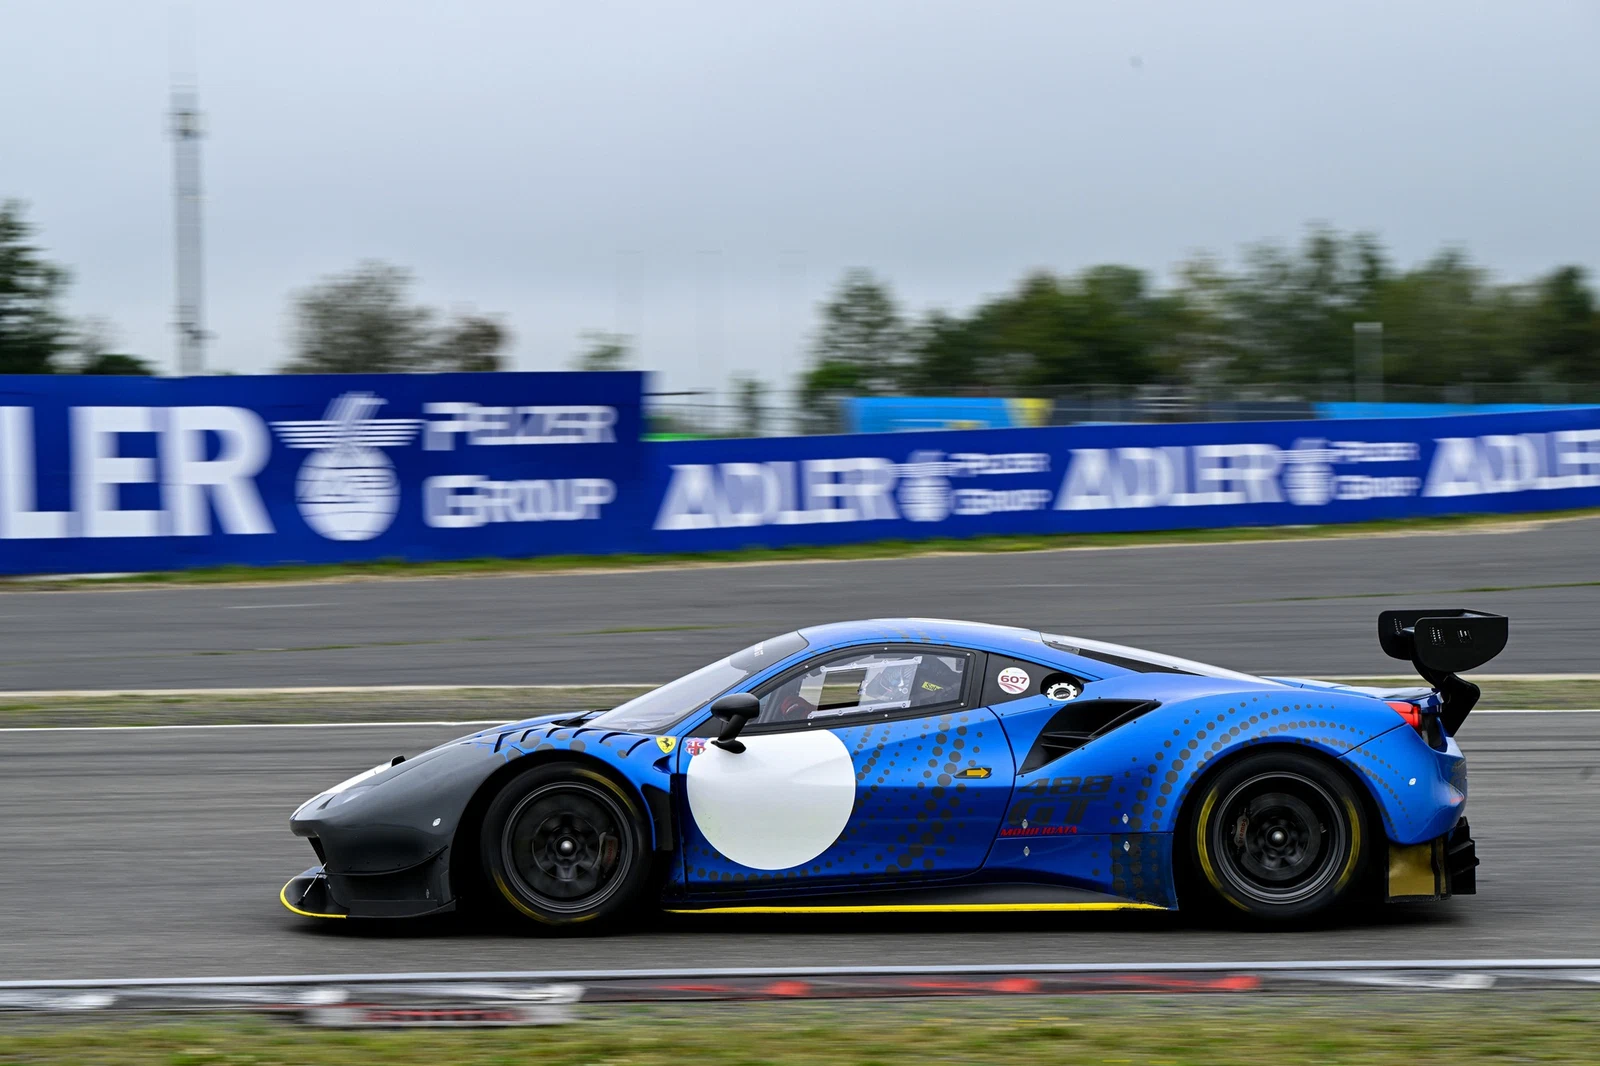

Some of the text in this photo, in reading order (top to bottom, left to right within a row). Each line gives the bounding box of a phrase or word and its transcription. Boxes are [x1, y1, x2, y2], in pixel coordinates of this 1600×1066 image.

[1053, 443, 1285, 510] ADLER
[1421, 429, 1600, 497] ADLE
[652, 457, 901, 530] ADLER
[1000, 675, 1028, 684] 607
[1017, 775, 1113, 795] 488
[1008, 795, 1106, 825] GT
